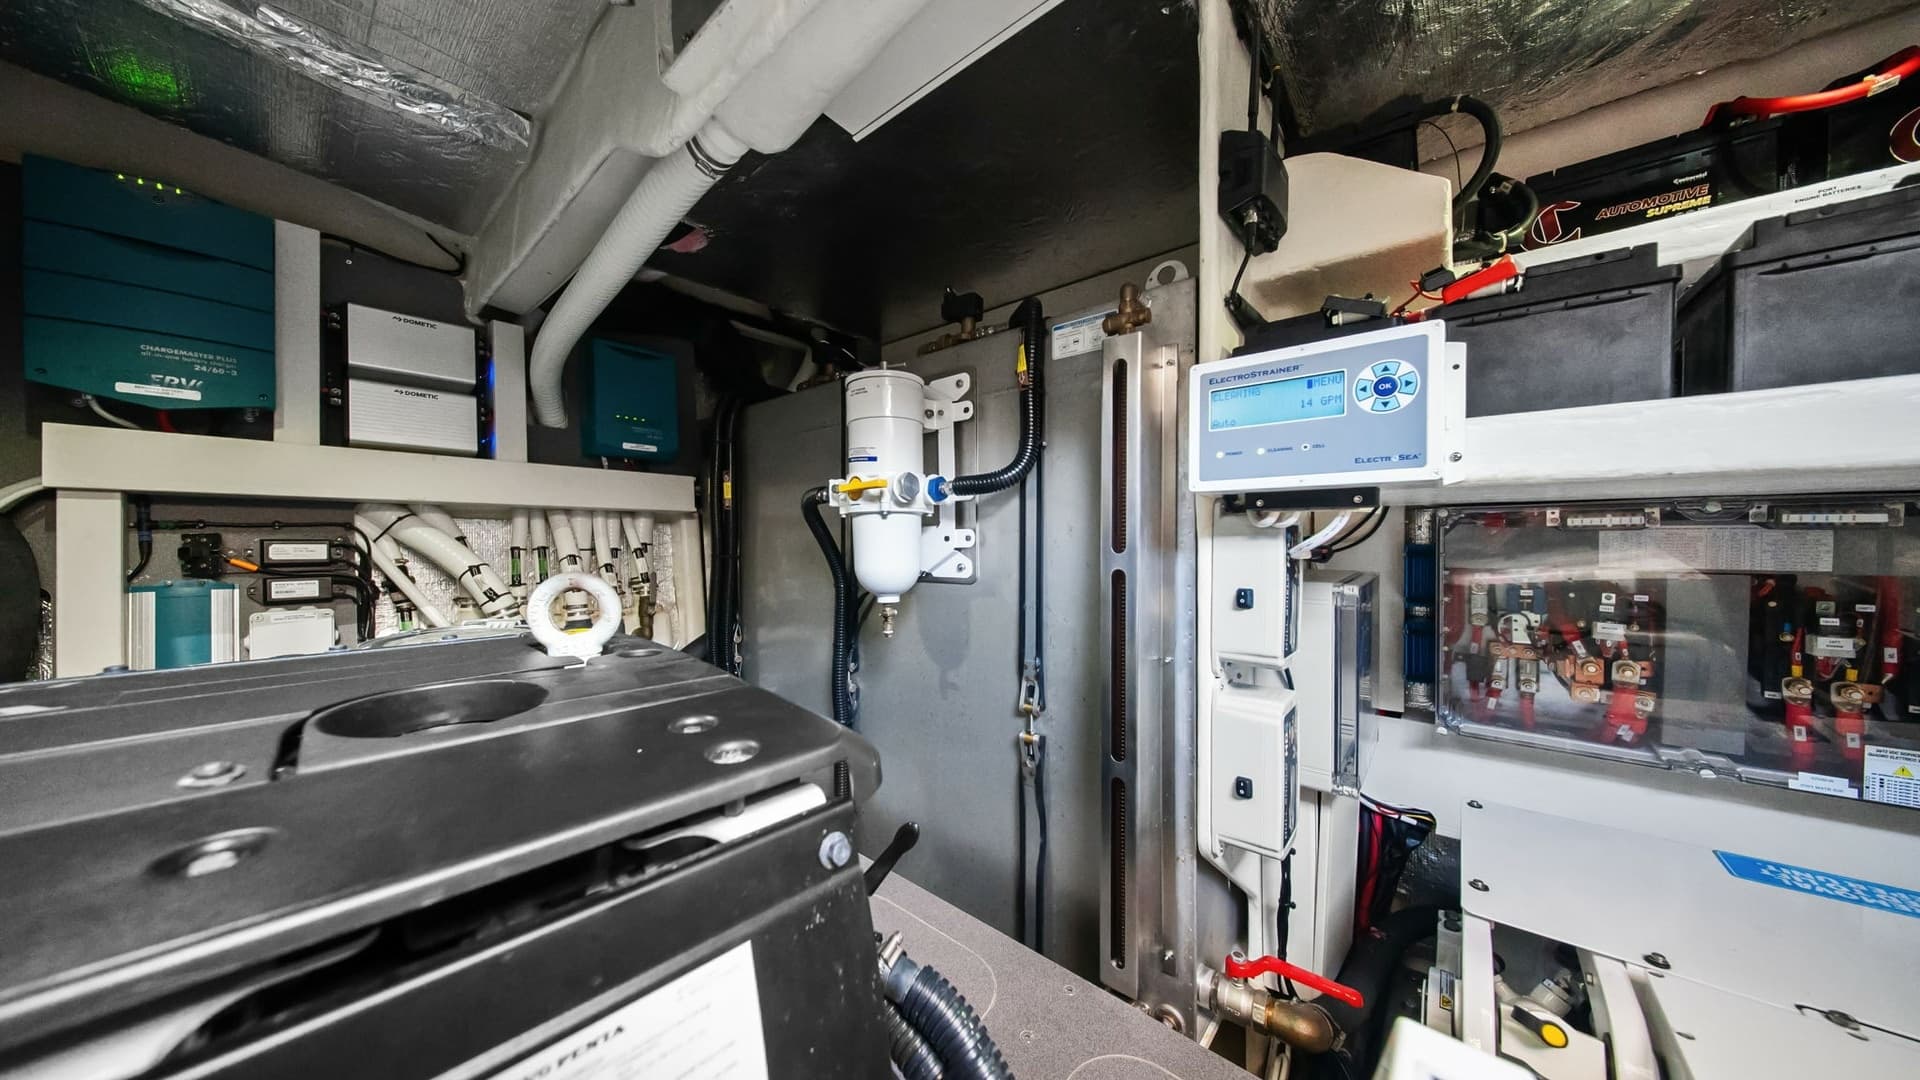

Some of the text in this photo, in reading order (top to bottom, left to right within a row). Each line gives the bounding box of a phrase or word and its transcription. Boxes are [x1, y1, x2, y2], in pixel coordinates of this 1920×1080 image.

[1594, 183, 1710, 220] AUTOMOTIVE
[1645, 195, 1712, 218] SUPREME
[402, 317, 438, 330] DOMETIC
[140, 344, 238, 364] CHARGEMASTER PLUS
[1209, 364, 1301, 386] ELECTROSTRAINER
[1312, 371, 1343, 388] MENU
[1378, 382, 1392, 391] OK
[404, 390, 440, 401] DOMETIC
[1300, 395, 1343, 409] 14 GPM
